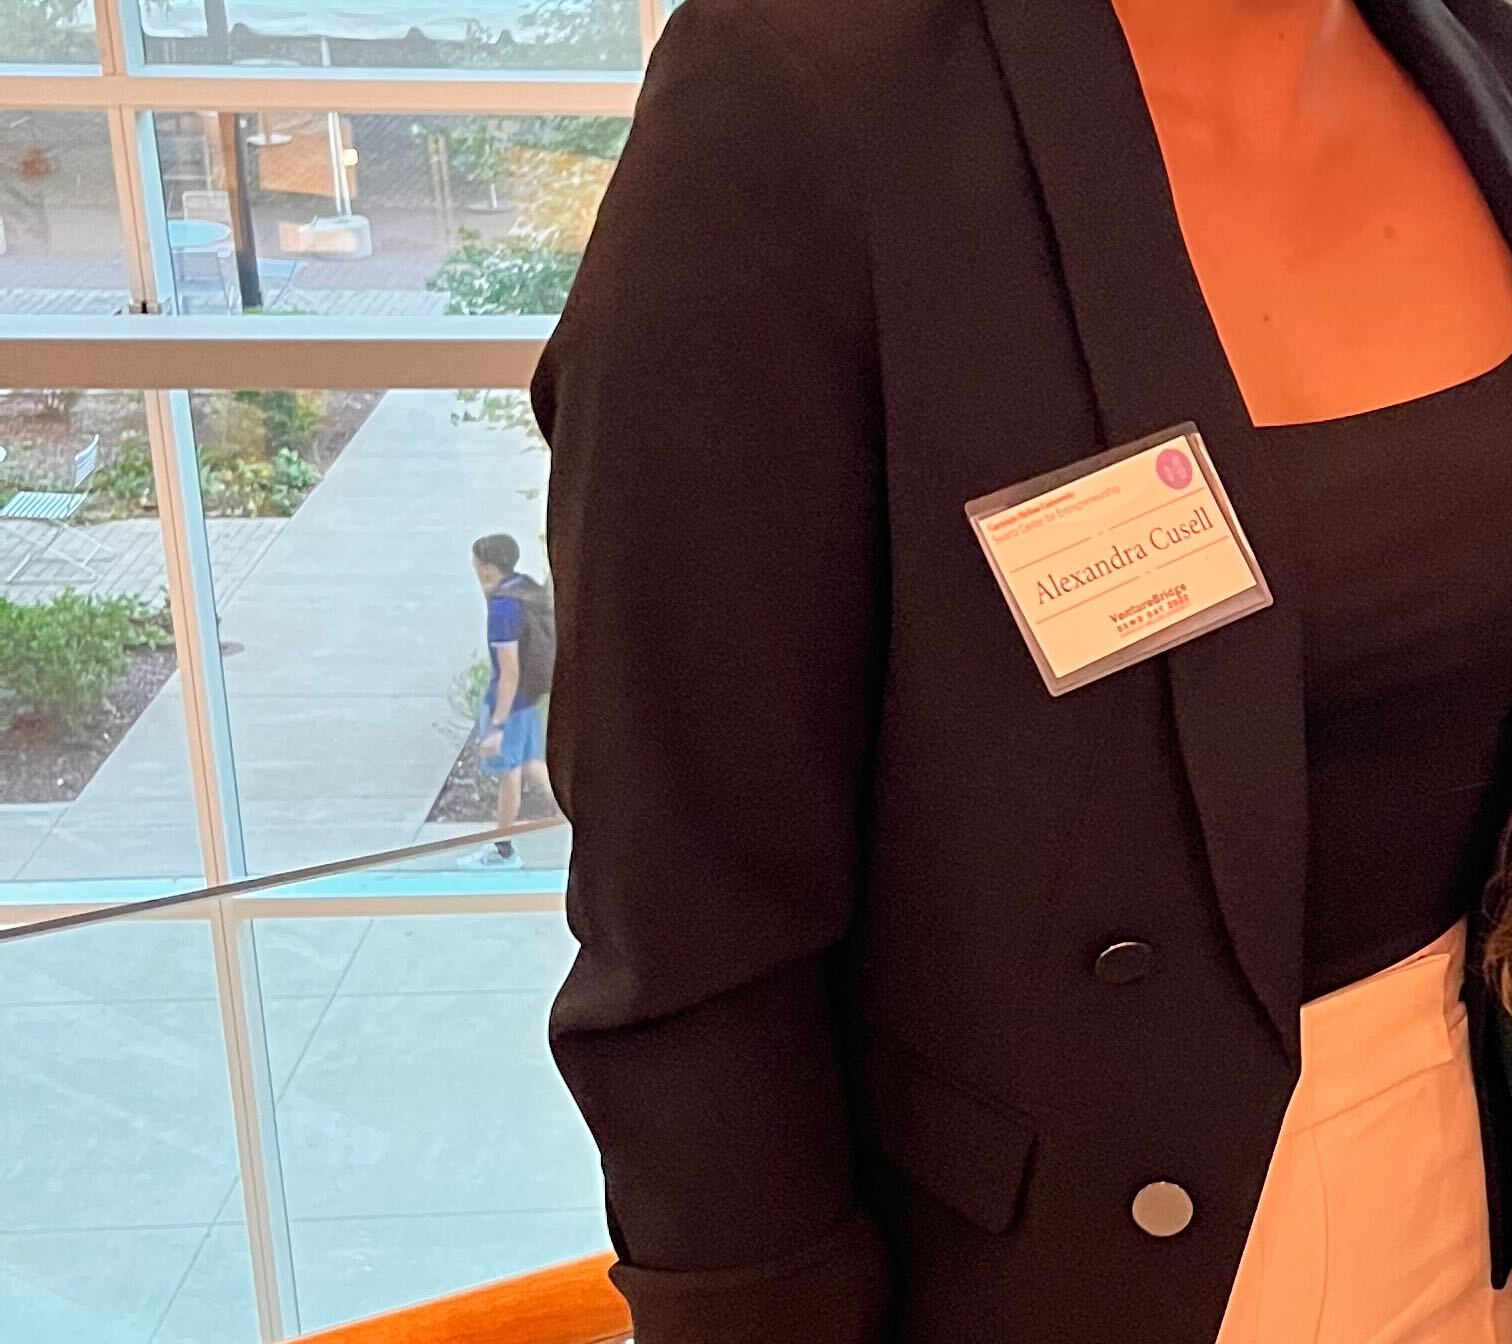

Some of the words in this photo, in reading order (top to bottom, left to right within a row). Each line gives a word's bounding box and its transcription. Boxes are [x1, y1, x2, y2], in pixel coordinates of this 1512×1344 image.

[1036, 544, 1148, 605] Alexandra
[1149, 506, 1214, 551] Cusell
[1109, 583, 1187, 623] VentureBridge
